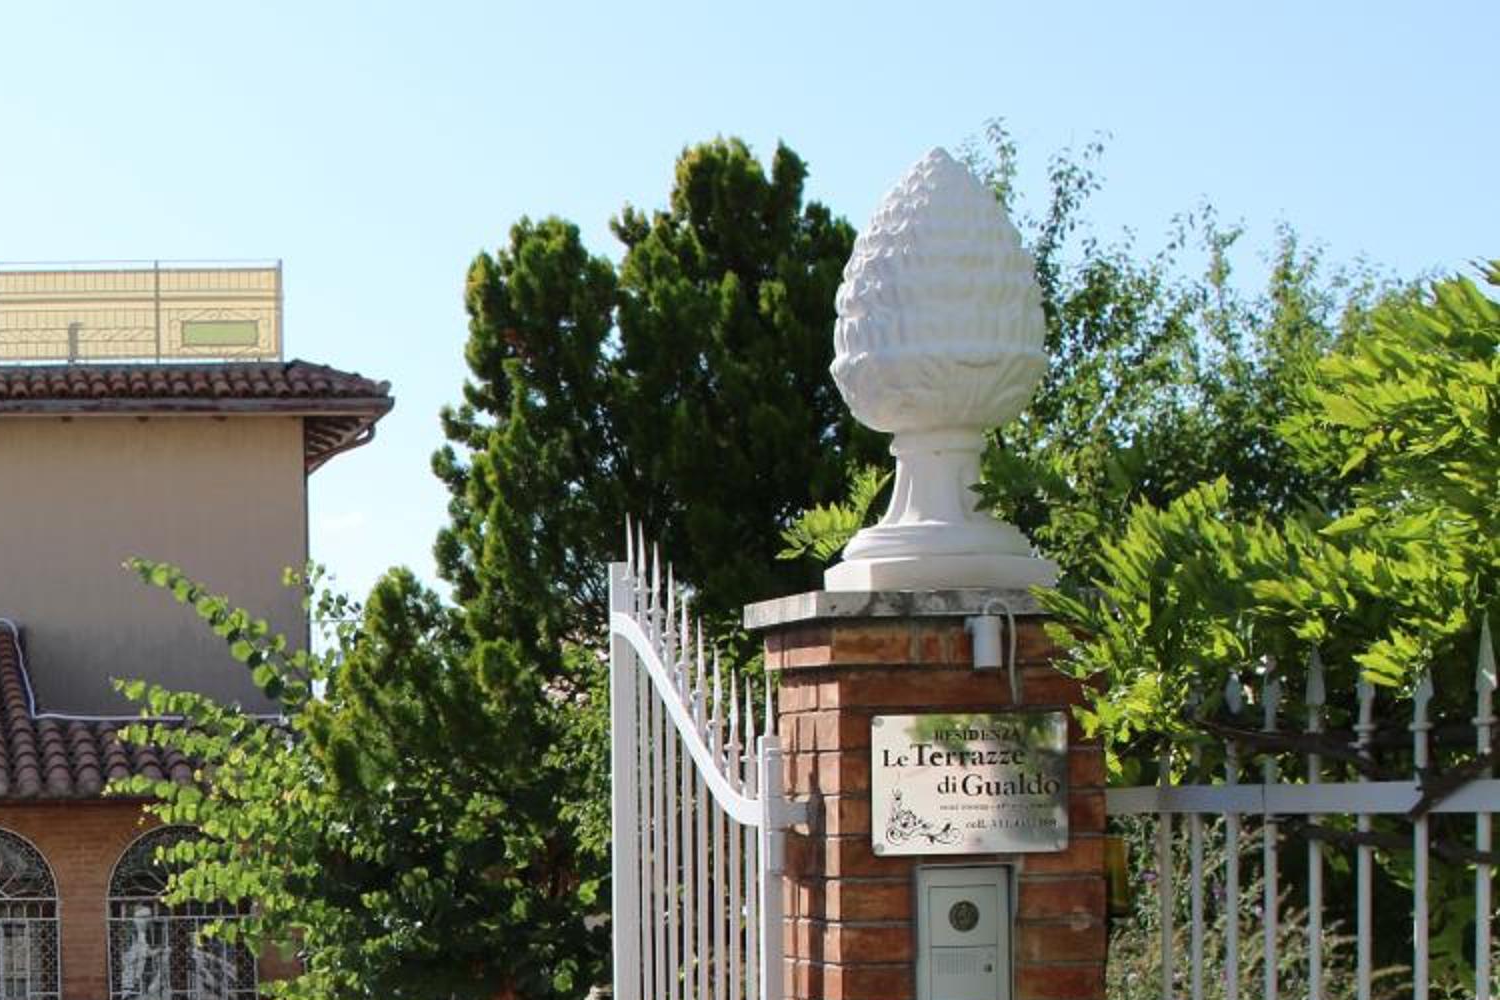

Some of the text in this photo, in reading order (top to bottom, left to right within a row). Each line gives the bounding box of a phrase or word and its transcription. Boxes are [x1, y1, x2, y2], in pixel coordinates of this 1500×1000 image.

[933, 728, 1021, 741] RESIDENZA
[883, 743, 1026, 768] Le Terrazze
[937, 772, 1060, 797] di Gualdo
